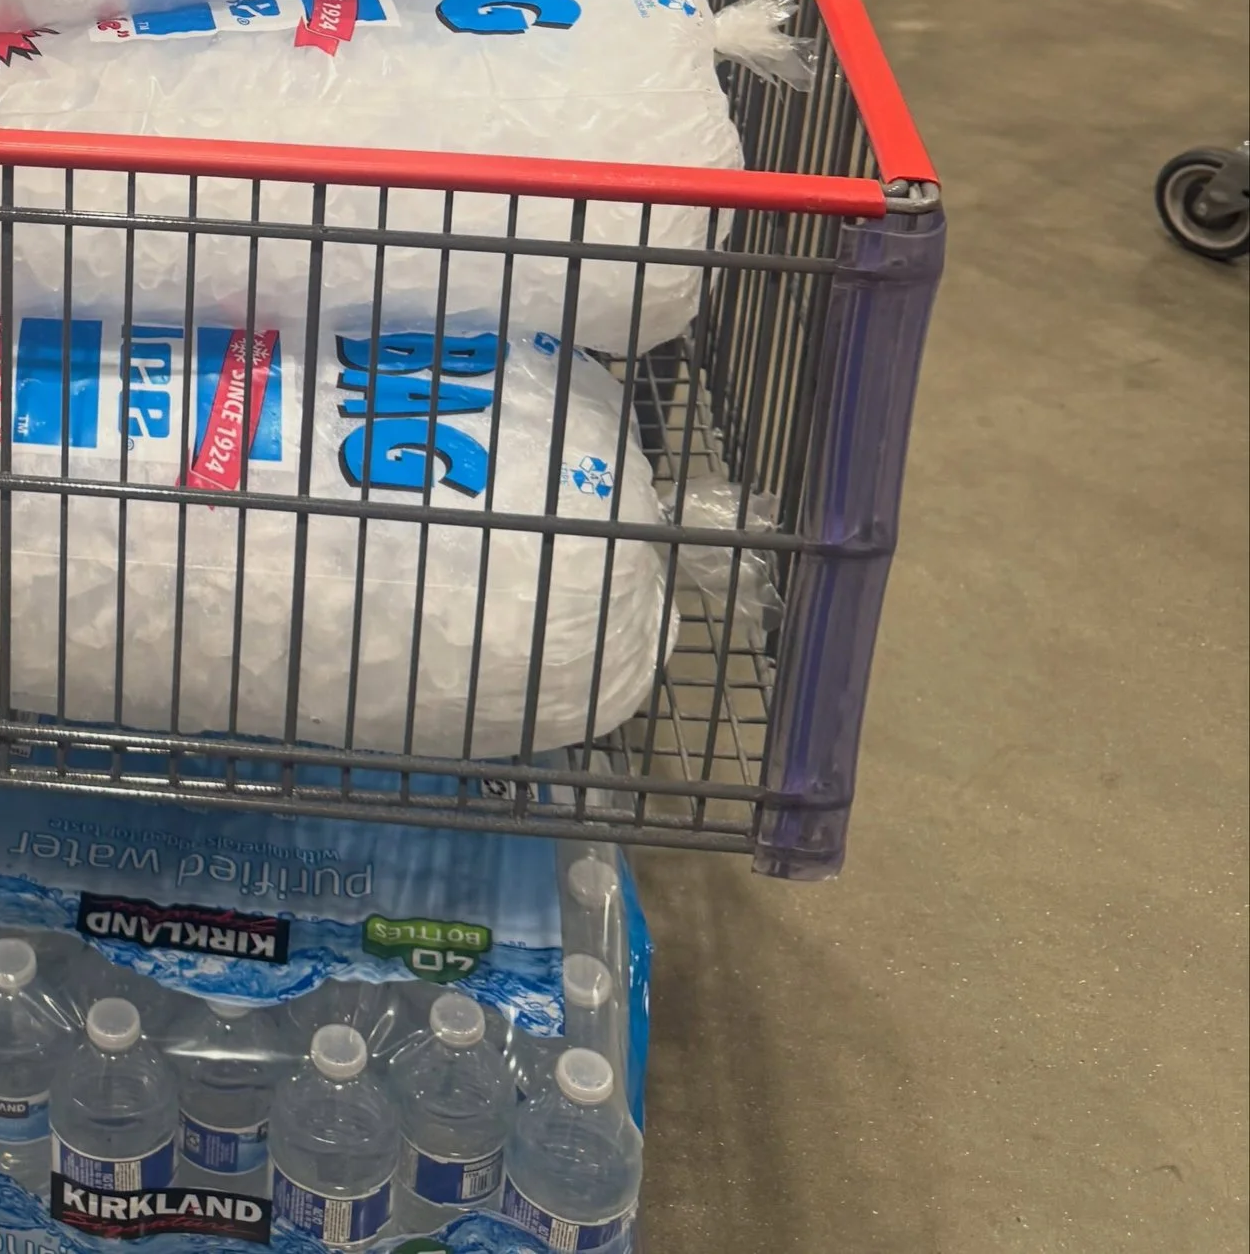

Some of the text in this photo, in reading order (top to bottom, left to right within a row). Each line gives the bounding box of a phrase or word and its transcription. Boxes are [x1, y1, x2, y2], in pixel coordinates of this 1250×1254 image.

[318, 2, 341, 31] 1924
[118, 323, 185, 439] Ice
[206, 366, 248, 474] SINCE 1924
[335, 331, 511, 499] BAG
[48, 818, 101, 838] taste
[9, 830, 374, 900] purified water
[205, 836, 291, 863] minerals
[295, 845, 342, 865] with
[86, 911, 276, 958] KIRKLAND
[374, 922, 481, 946] BOTTLES
[411, 948, 475, 972] 40
[63, 1182, 262, 1223] KIRKLAND
